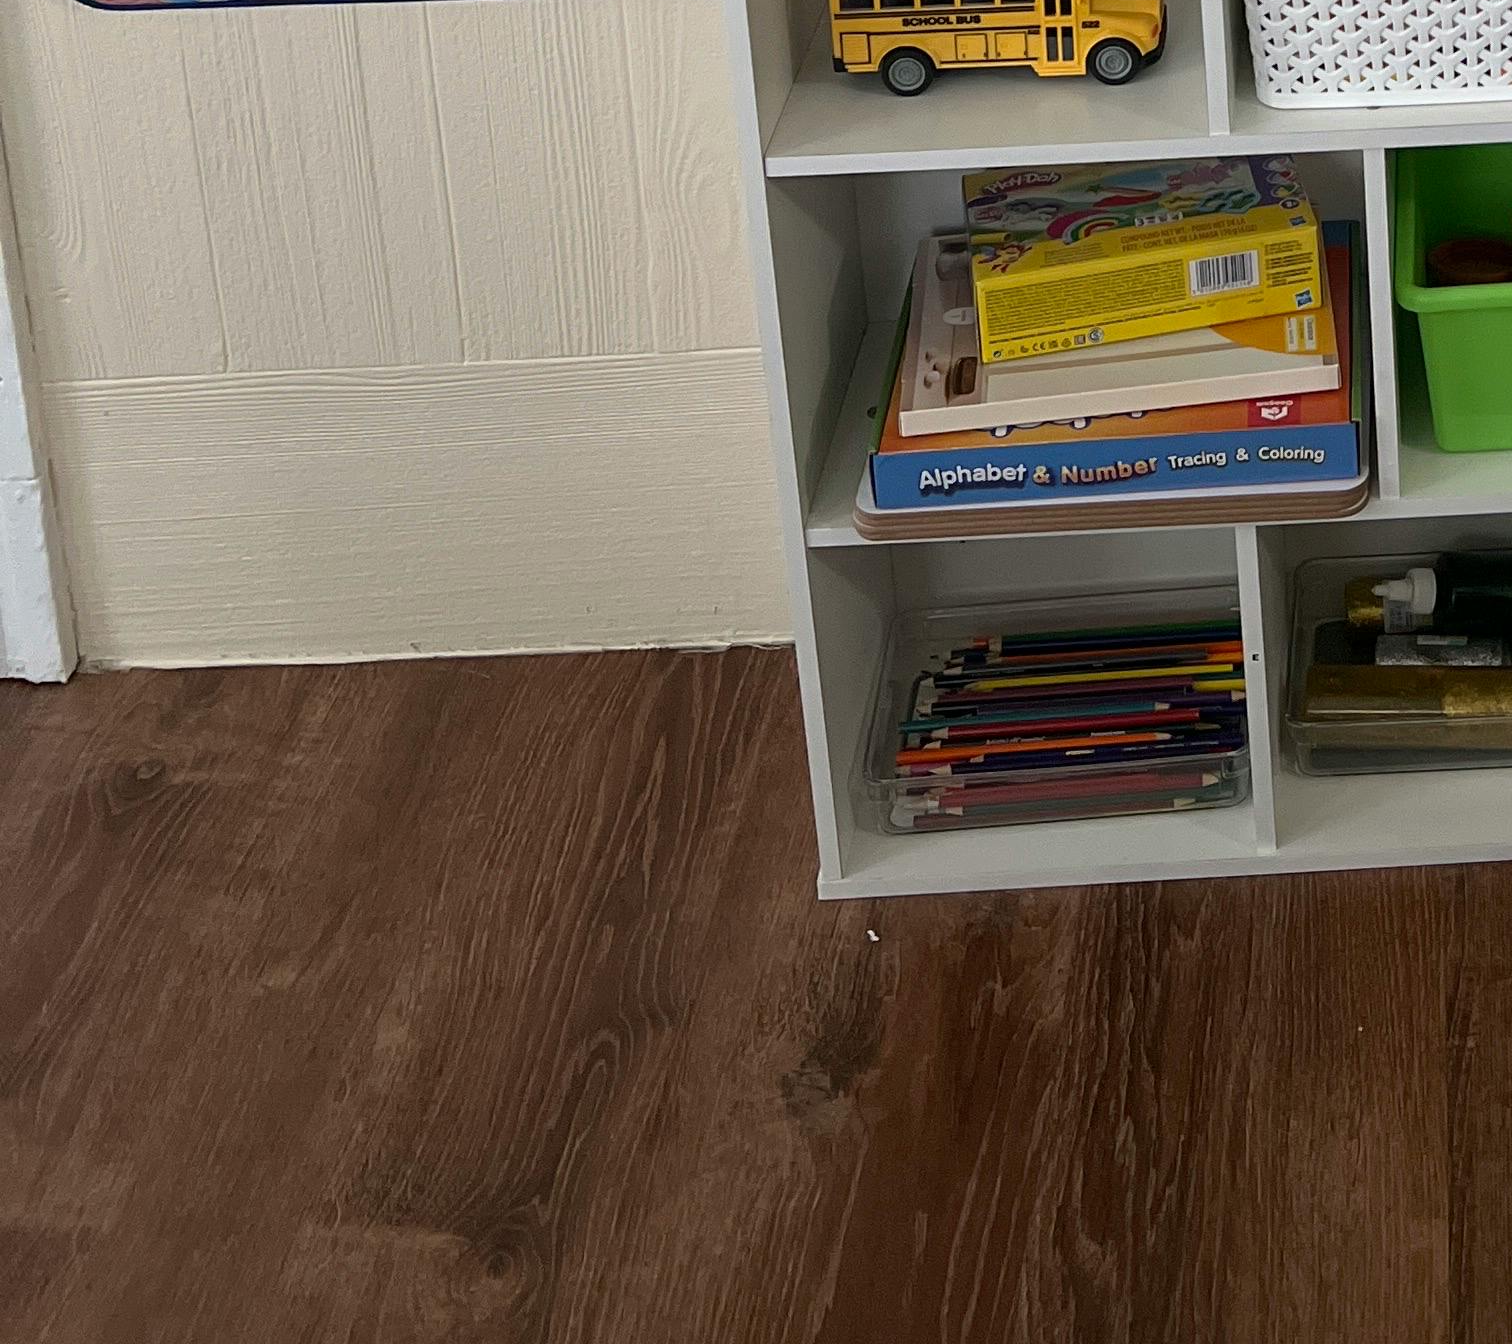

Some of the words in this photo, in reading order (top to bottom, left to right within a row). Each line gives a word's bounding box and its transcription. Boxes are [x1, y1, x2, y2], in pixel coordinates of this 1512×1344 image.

[902, 16, 954, 27] SCHOOL
[955, 15, 981, 25] BUS
[918, 462, 1027, 492] Alphabet
[1033, 465, 1051, 485] &
[1059, 455, 1159, 485] Number
[1167, 449, 1228, 471] Tracing
[1236, 447, 1250, 461] &
[1257, 445, 1326, 464] Coloring
